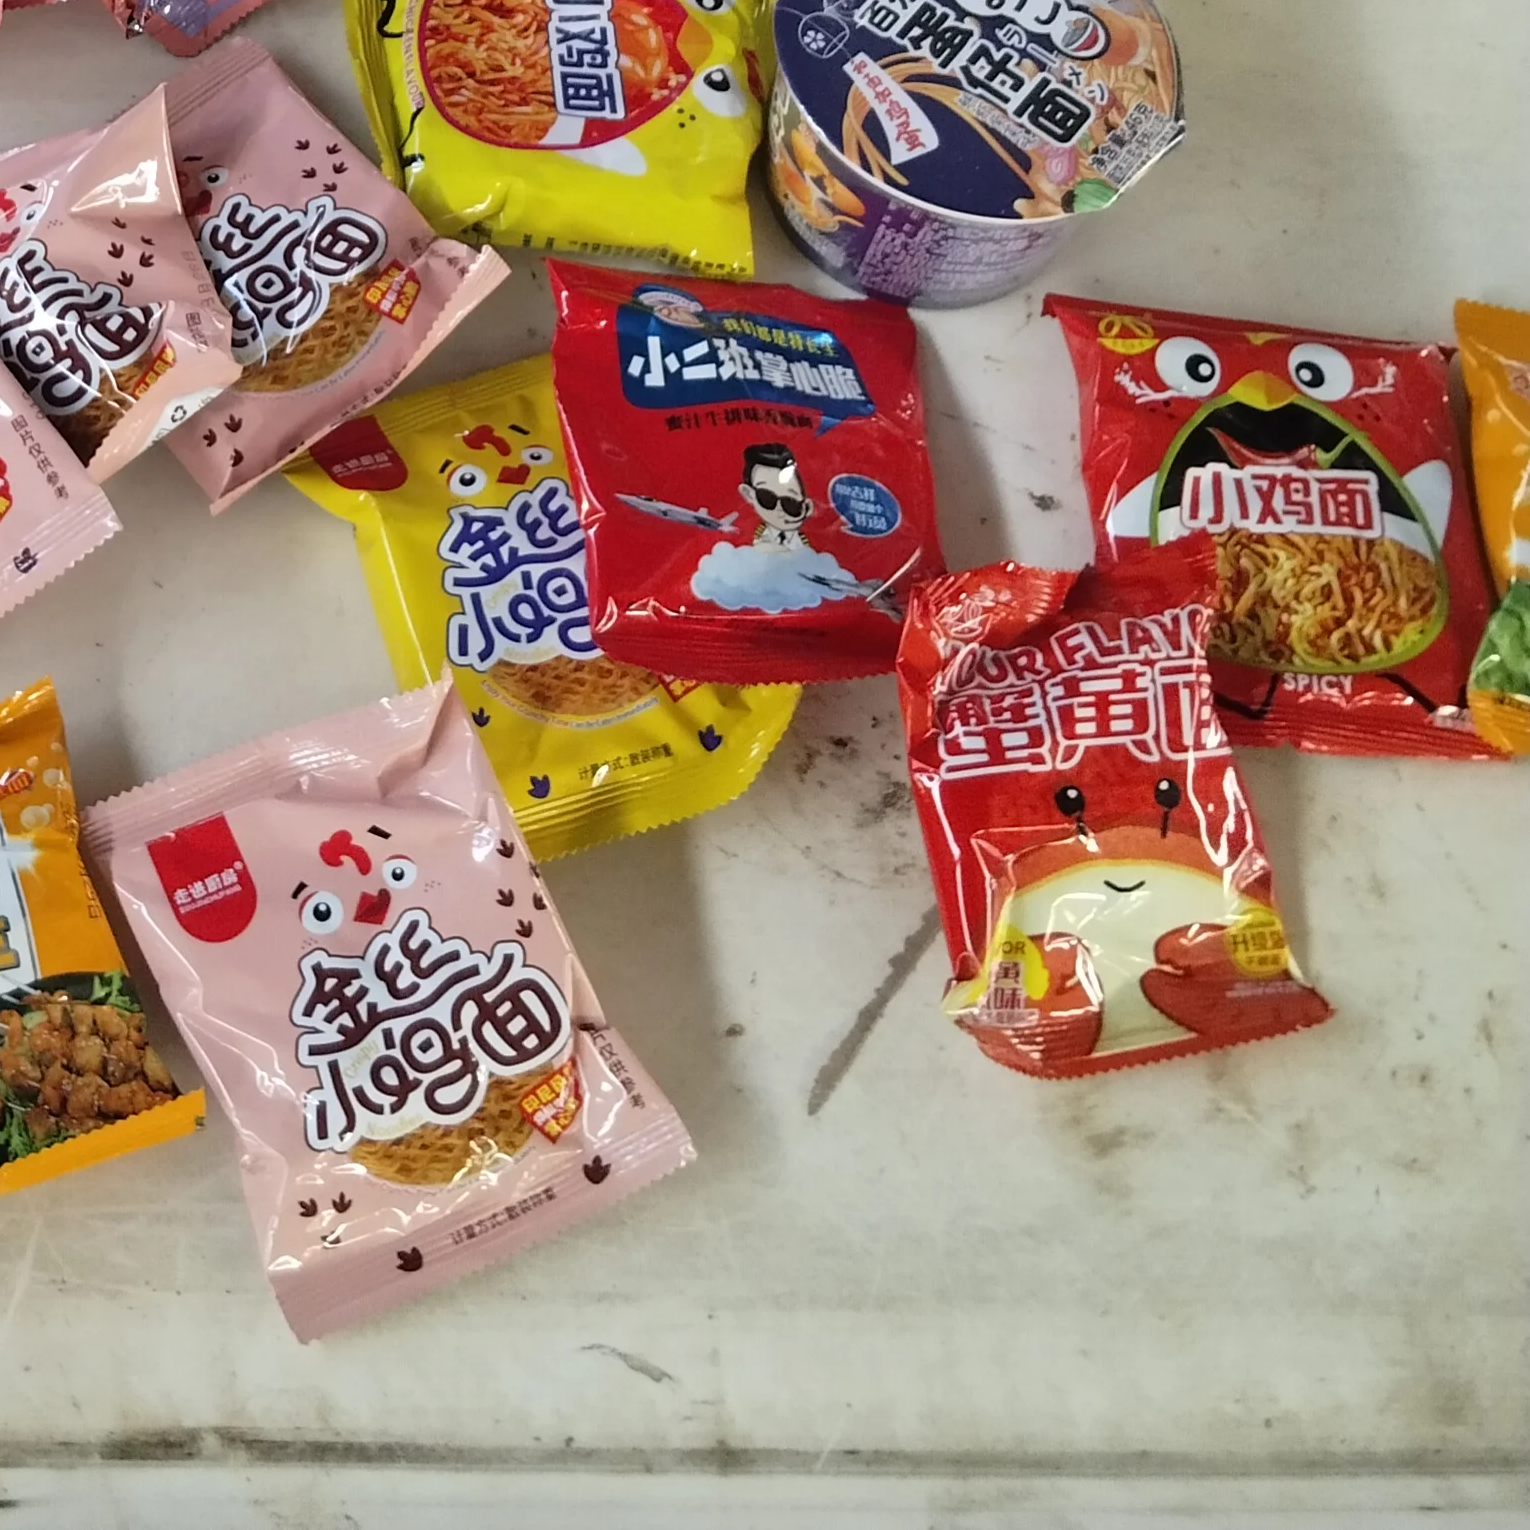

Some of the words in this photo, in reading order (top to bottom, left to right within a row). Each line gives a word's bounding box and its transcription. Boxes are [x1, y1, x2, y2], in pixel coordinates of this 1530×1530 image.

[899, 2, 1092, 141] 蛋仔面
[997, 25, 1108, 104] ラーメン
[1089, 101, 1155, 168] 净含量:46克
[627, 335, 867, 403] 小二班掌心脆
[721, 316, 840, 359] 我们都是特长生
[10, 414, 72, 502] 图片仅供参考
[1188, 470, 1372, 531] 小鸡面
[1282, 673, 1355, 696] SPICY
[171, 870, 239, 907] 走进厨房
[302, 920, 482, 1058] 金丝
[450, 1186, 559, 1248] 计量方式:散装称重
